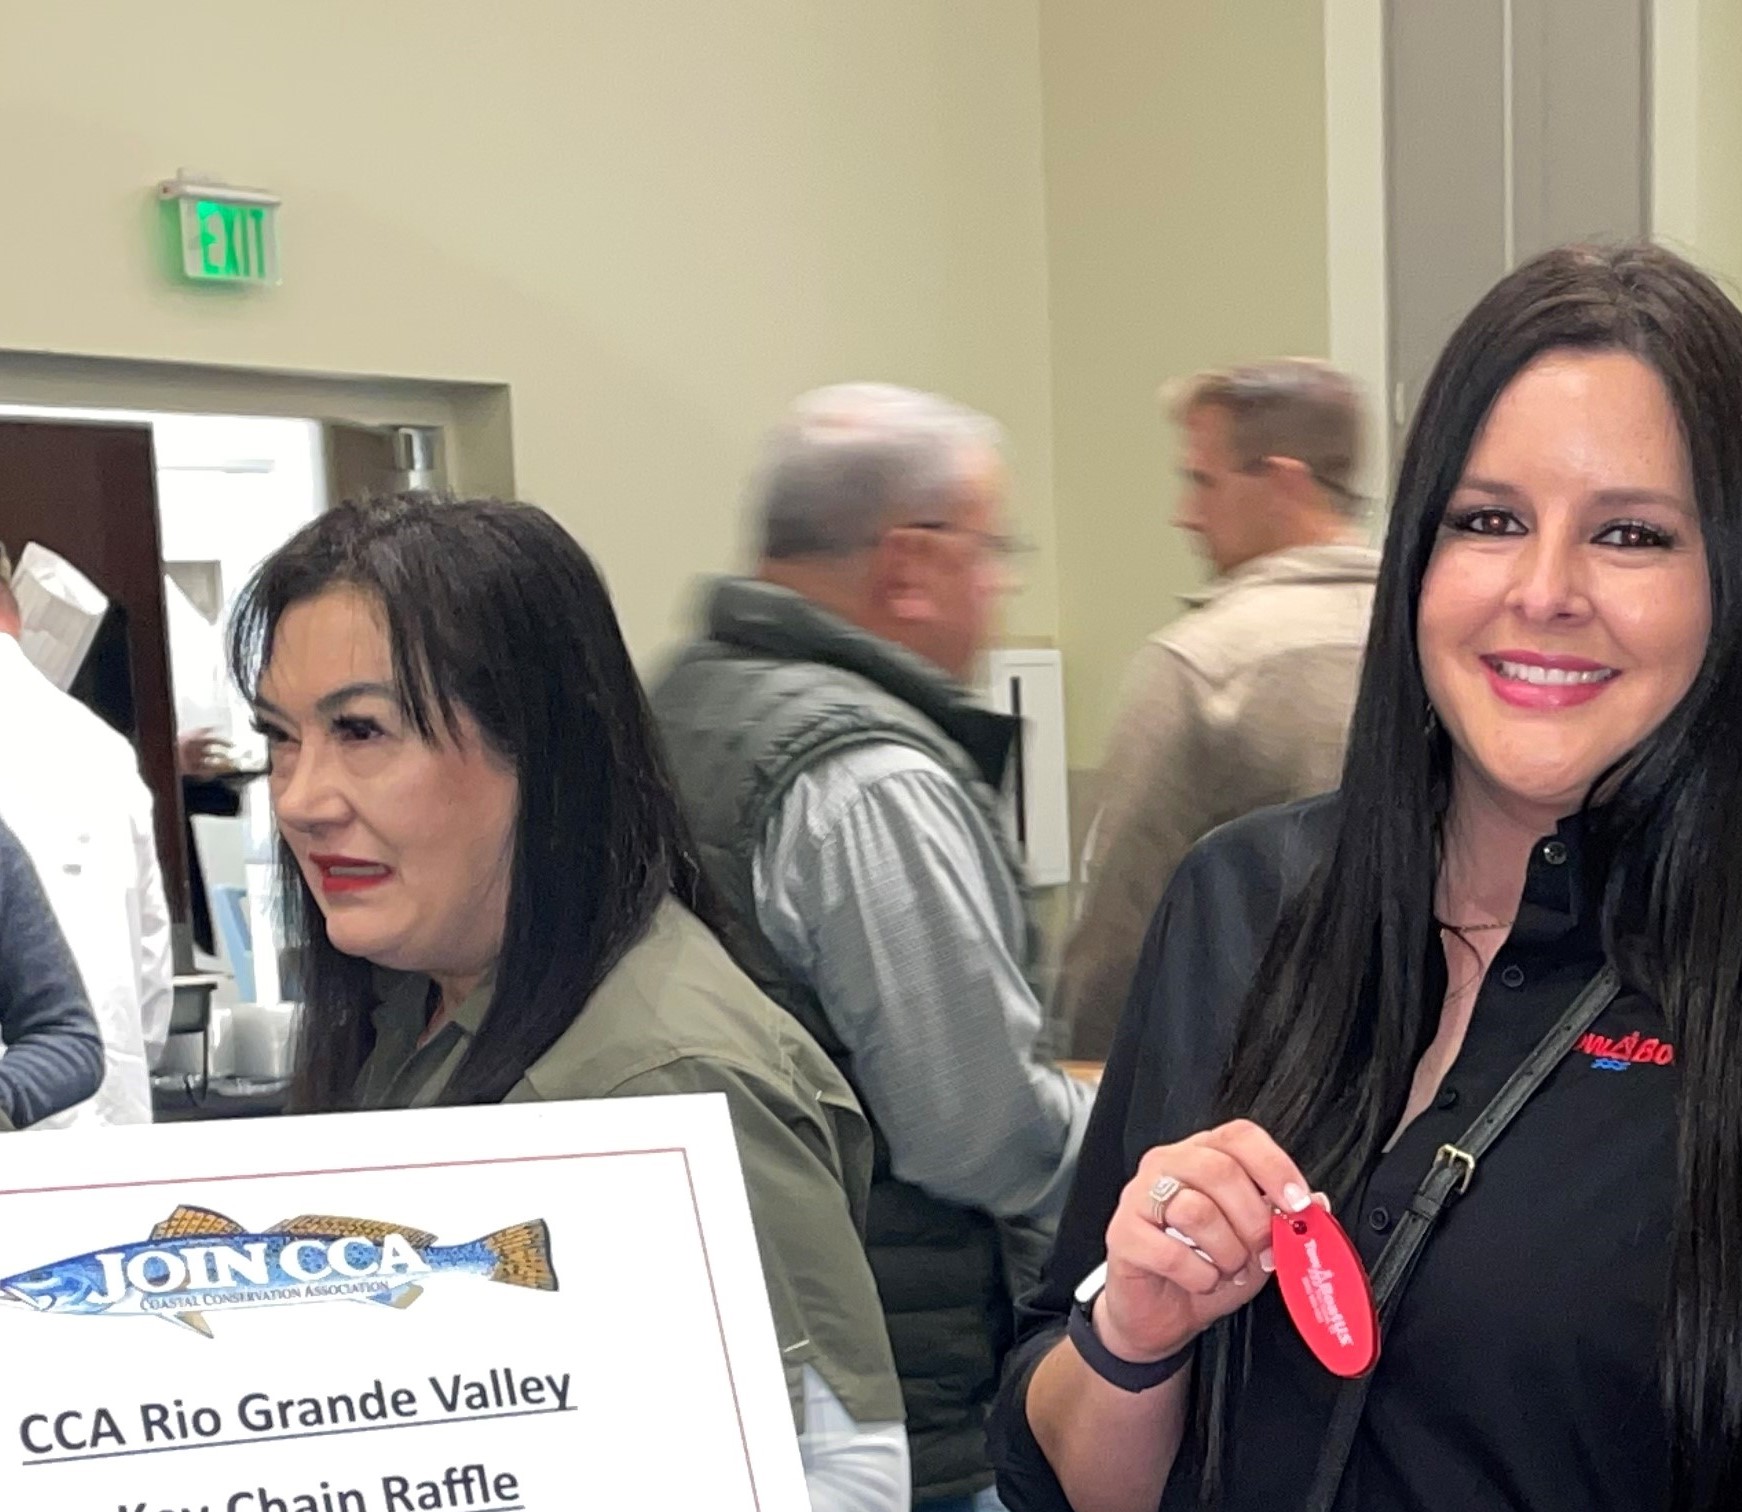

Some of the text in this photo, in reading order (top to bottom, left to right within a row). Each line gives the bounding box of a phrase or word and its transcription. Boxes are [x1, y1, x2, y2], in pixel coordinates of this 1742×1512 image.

[196, 200, 265, 278] EXIT
[91, 1233, 433, 1303] JOIN CCA
[20, 1367, 571, 1454] CCA Rio Grande Valley
